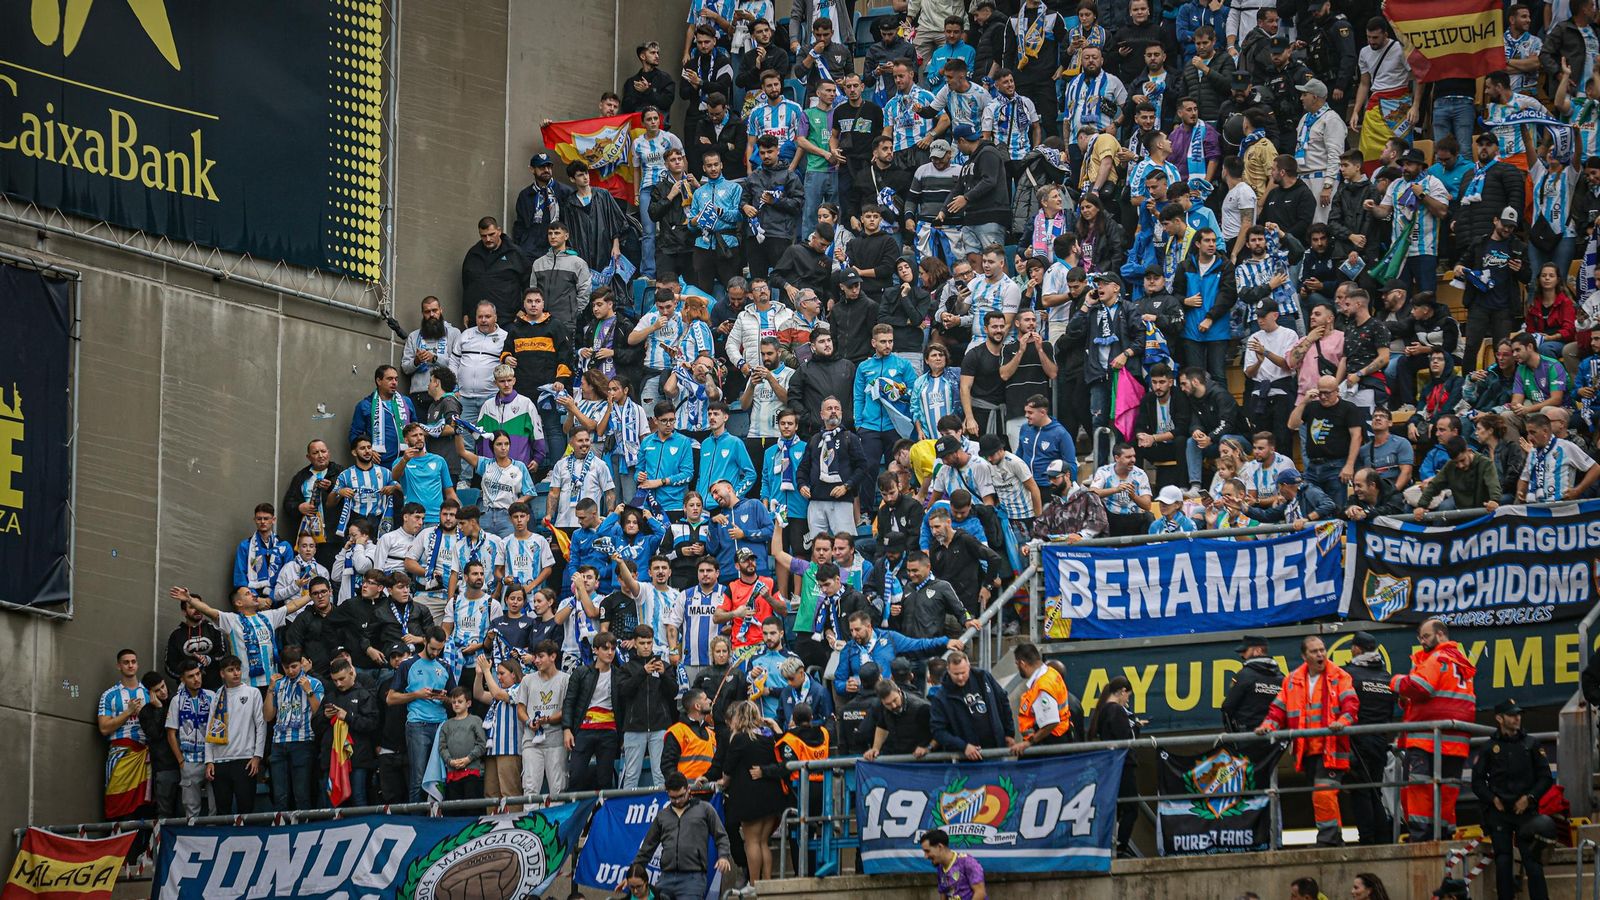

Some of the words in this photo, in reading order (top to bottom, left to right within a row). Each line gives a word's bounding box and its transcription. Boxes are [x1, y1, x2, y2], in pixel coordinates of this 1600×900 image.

[1403, 20, 1496, 50] CHIDONA
[1366, 533, 1441, 565] PEÑA
[1058, 537, 1335, 620] BENAMIEL
[1415, 563, 1589, 612] ARCHIDONA
[689, 606, 716, 615] MALAG
[862, 787, 929, 841] 19
[1019, 783, 1096, 840] 04
[436, 833, 509, 870] MÁLAGA
[510, 833, 537, 852] CLUB
[527, 852, 541, 878] DE
[1220, 829, 1254, 846] FANS
[159, 823, 418, 900] FONDO
